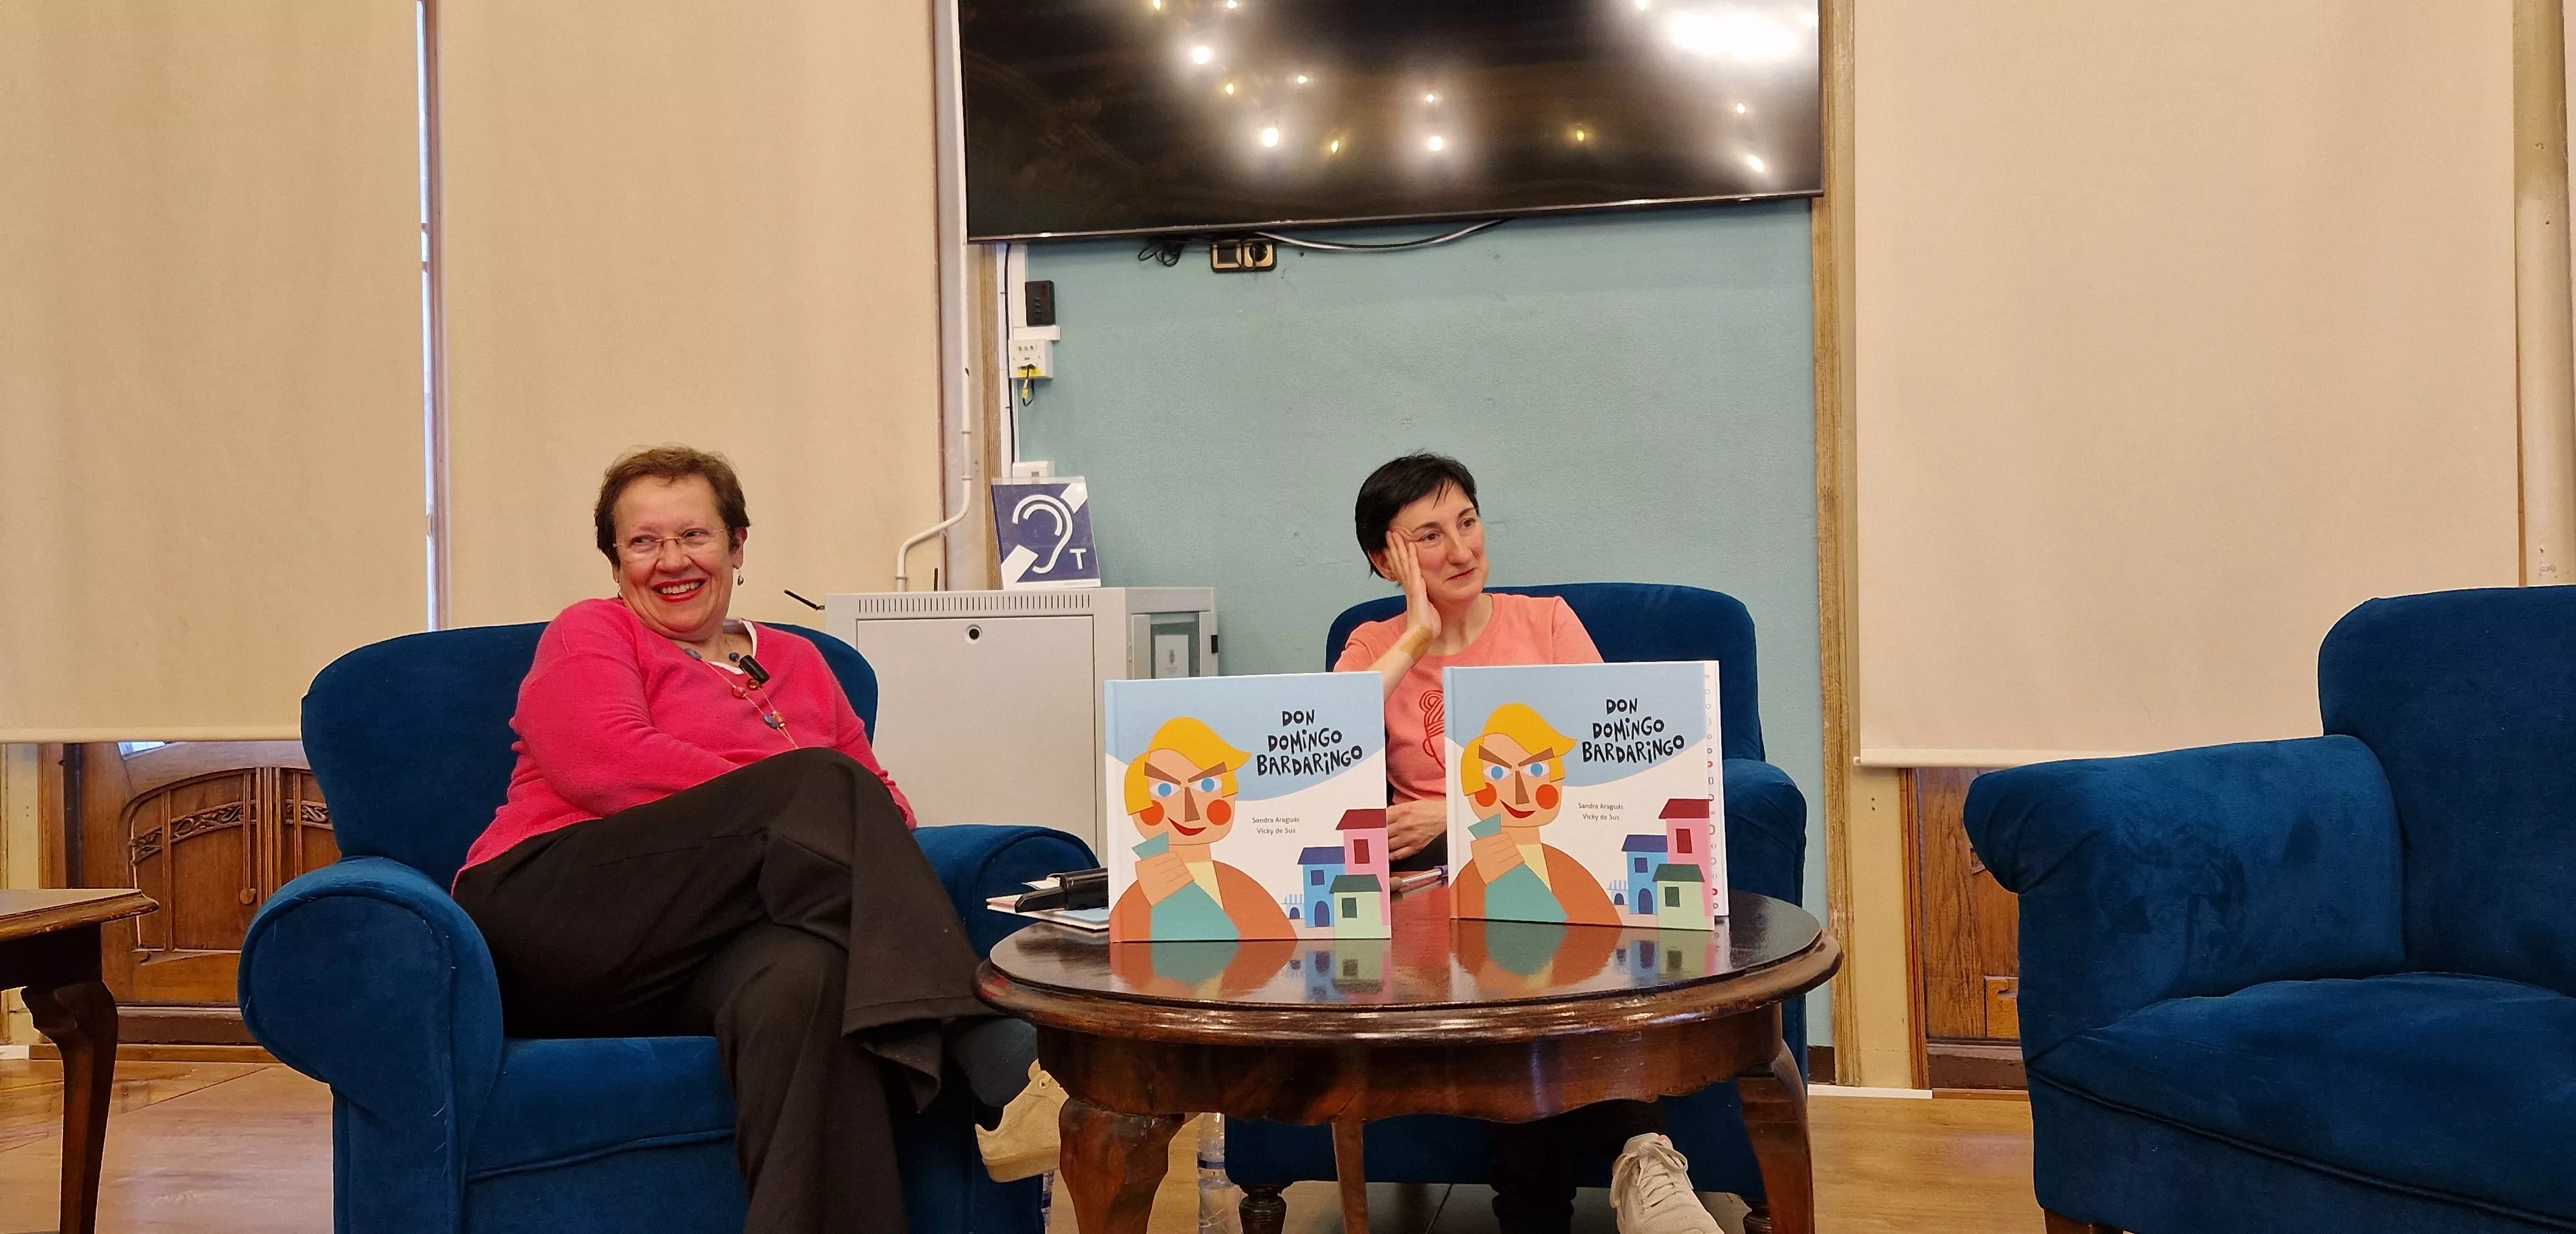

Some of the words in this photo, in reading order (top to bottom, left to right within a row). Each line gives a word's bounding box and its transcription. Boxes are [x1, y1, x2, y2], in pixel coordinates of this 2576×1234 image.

[1070, 548, 1087, 570] T
[1605, 698, 1638, 715] DON
[1281, 709, 1315, 727] DON
[1583, 814, 1598, 822] Vicky
